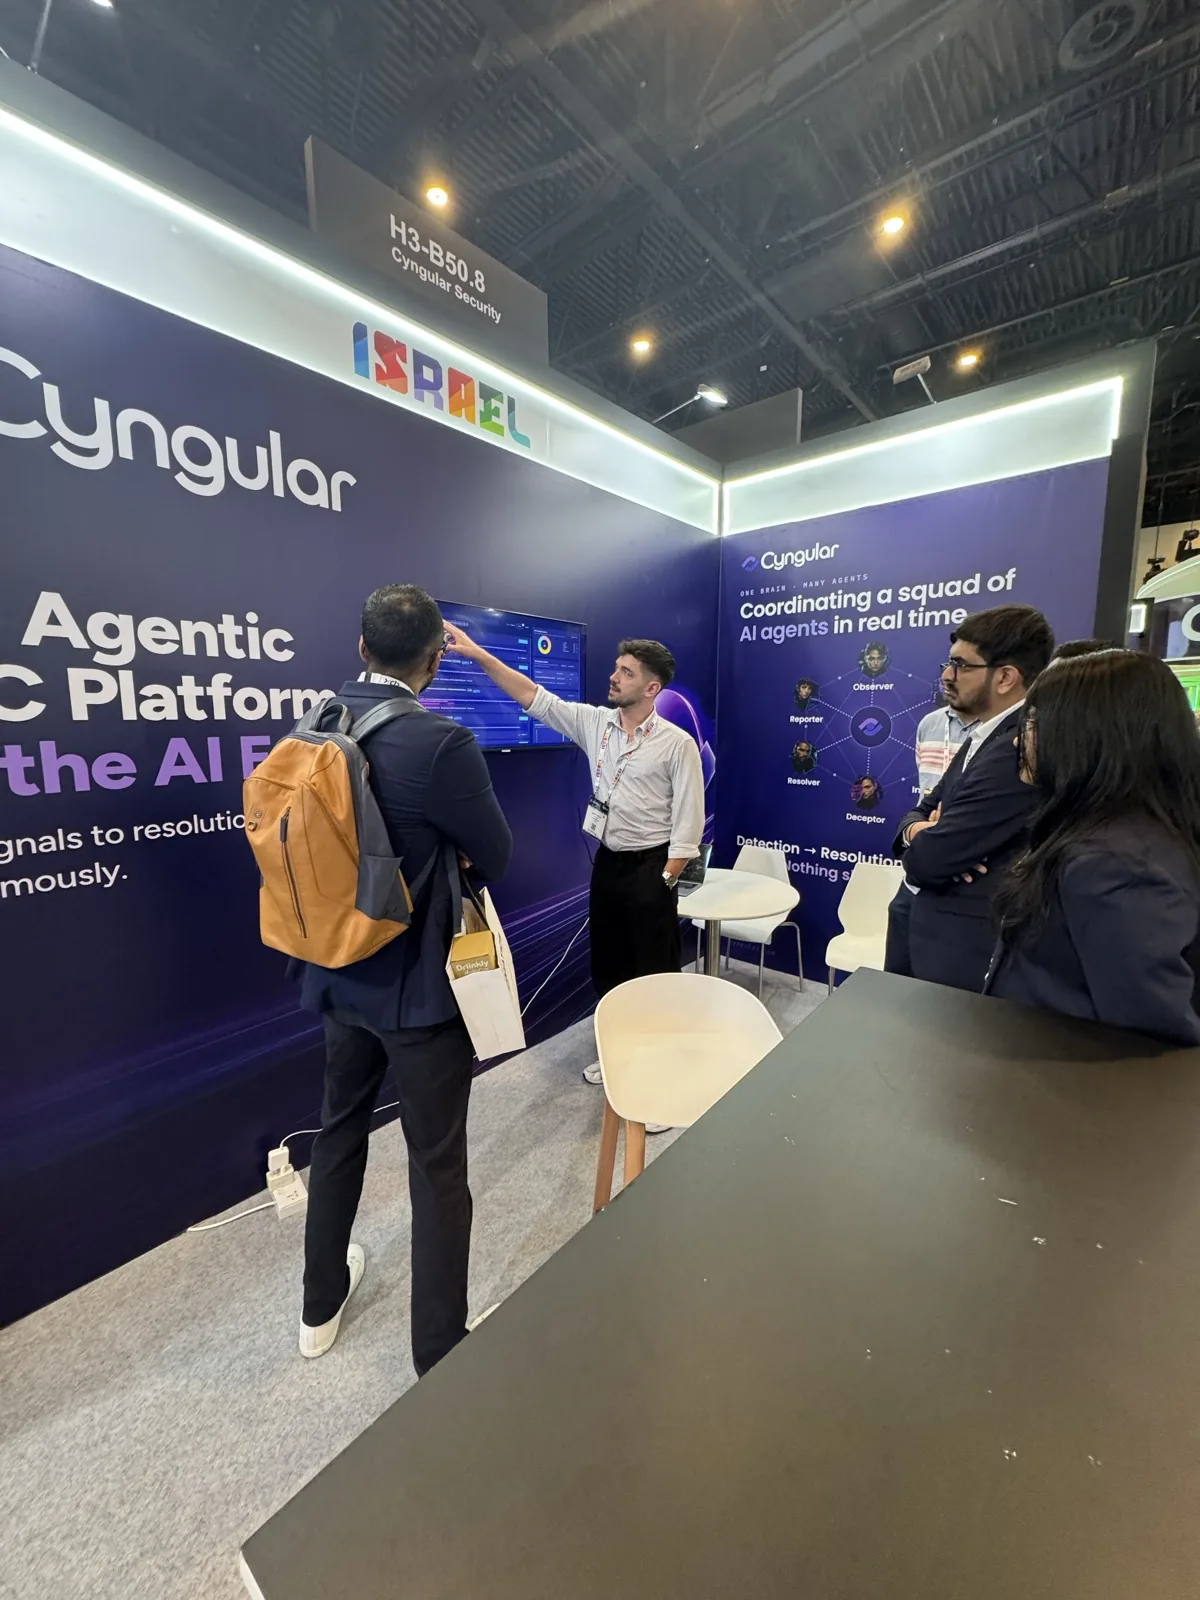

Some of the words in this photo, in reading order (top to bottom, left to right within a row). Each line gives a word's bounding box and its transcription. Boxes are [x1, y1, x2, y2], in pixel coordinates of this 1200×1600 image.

[390, 213, 486, 293] H3-B50.8
[391, 246, 452, 293] Cyngular
[454, 284, 502, 324] Security
[352, 321, 531, 449] ISRAEL
[760, 543, 840, 571] Cyngular
[740, 589, 755, 597] ONE
[760, 585, 787, 595] BRAIN
[803, 580, 826, 589] MANY
[832, 573, 869, 585] AGENTS
[740, 589, 872, 619] Coordinating
[876, 587, 892, 604] a
[898, 572, 981, 606] squad
[986, 567, 1017, 592] of
[21, 591, 295, 666] Agentic
[739, 625, 757, 642] AI
[760, 619, 829, 645] agents
[833, 614, 853, 635] in
[858, 610, 903, 632] real
[908, 606, 968, 628] time
[852, 681, 895, 692] Observer
[789, 715, 824, 725] Reporter
[0, 741, 137, 796] the
[154, 736, 223, 787] AI
[787, 777, 821, 787] Resolver
[90, 825, 125, 847] to
[133, 810, 246, 842] resolutio
[845, 812, 886, 825] Deceptor
[736, 835, 801, 855] Detection
